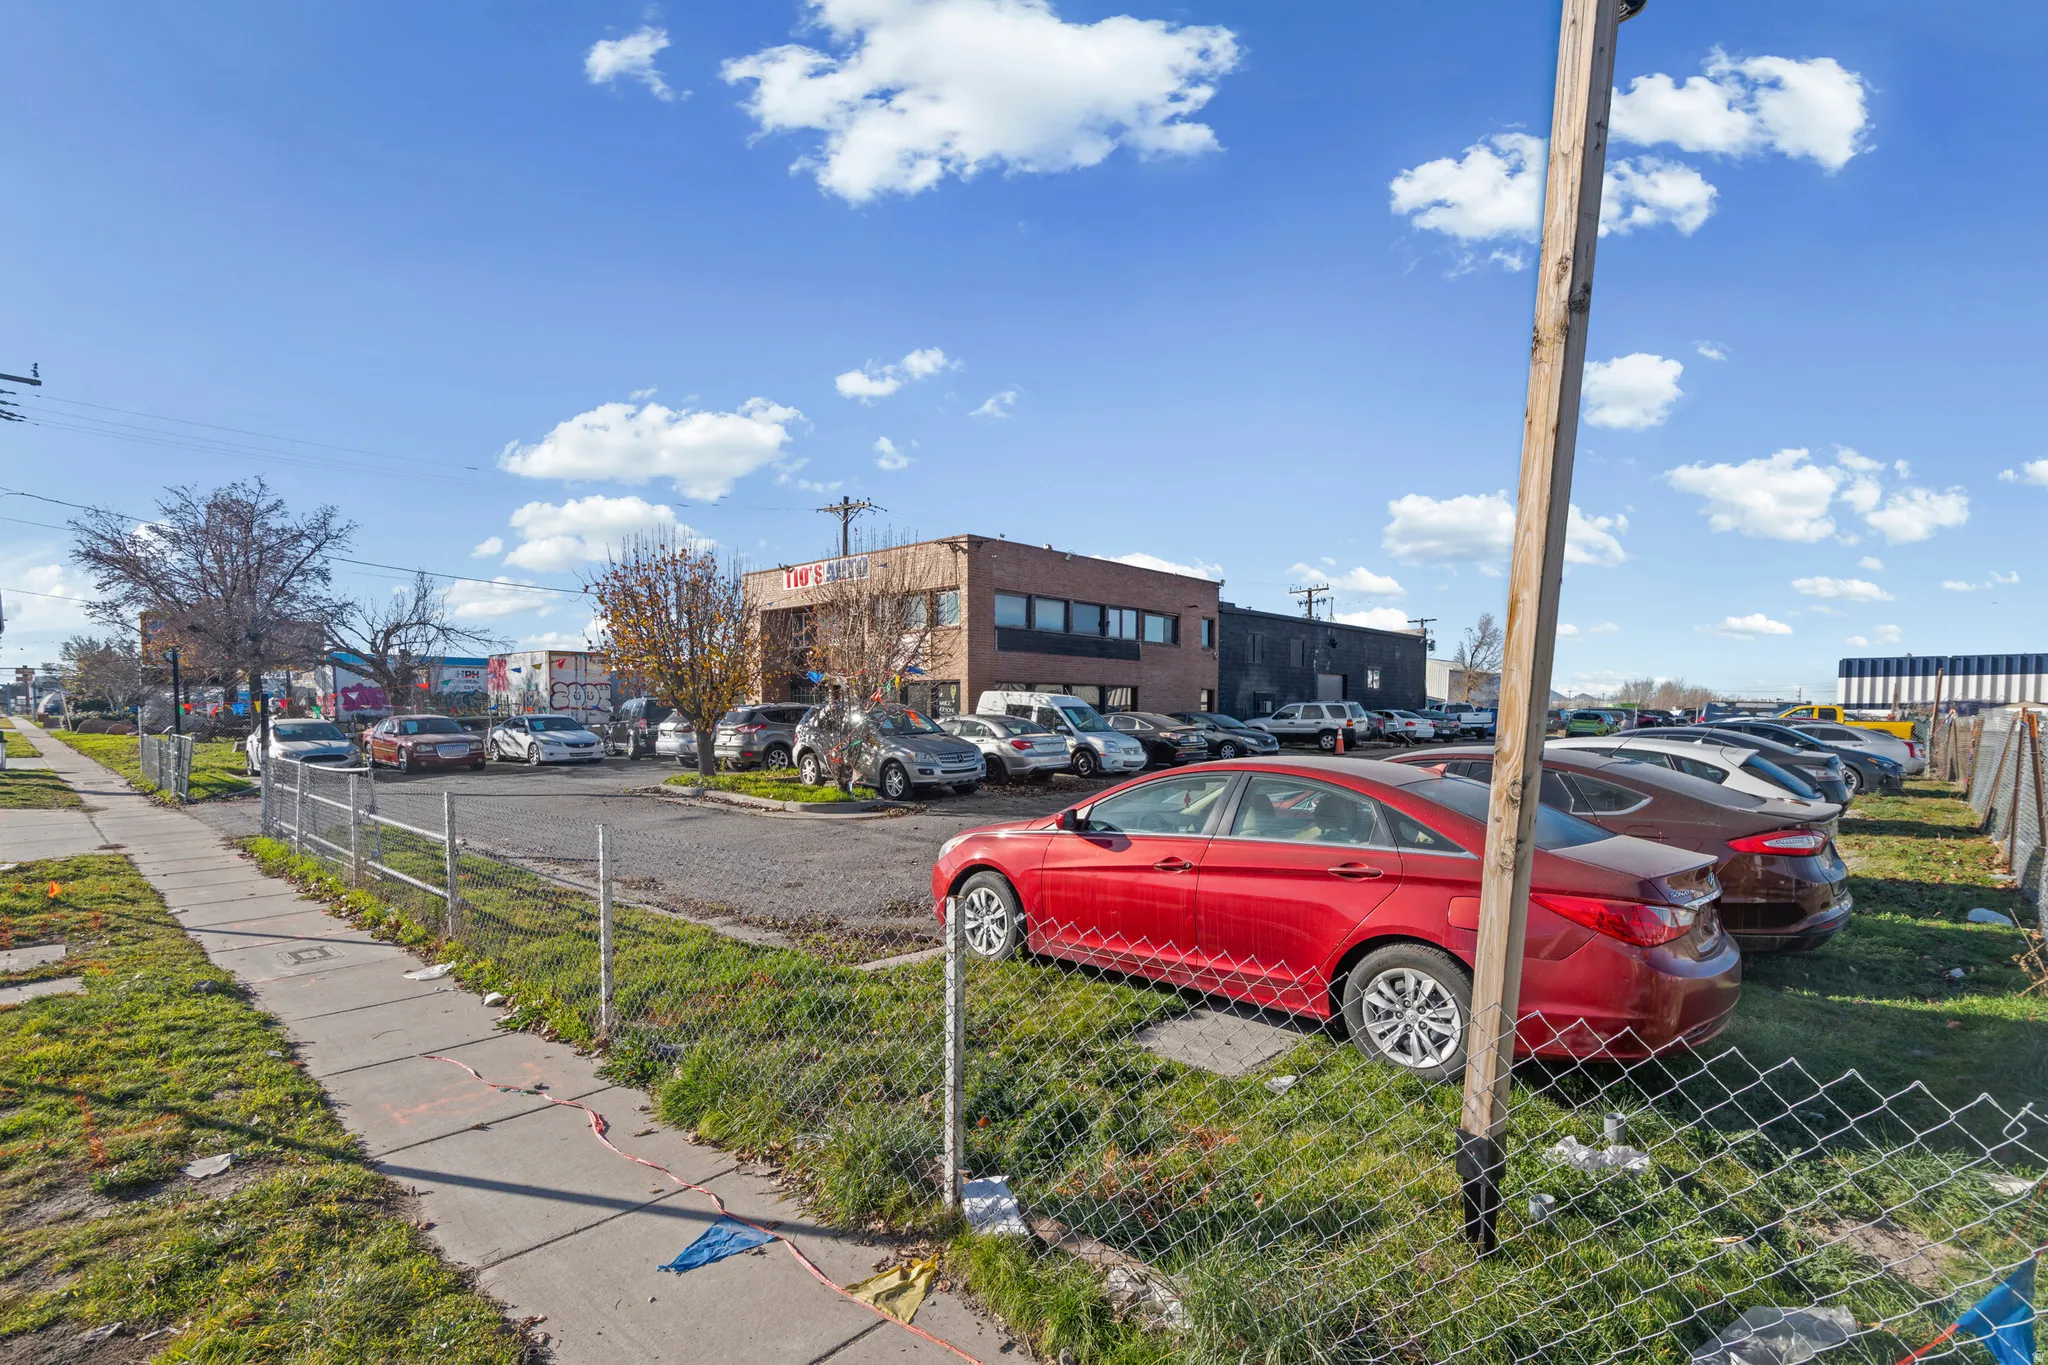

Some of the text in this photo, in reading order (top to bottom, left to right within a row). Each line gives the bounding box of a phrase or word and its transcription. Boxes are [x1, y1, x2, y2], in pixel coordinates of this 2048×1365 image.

[785, 556, 868, 589] TIO'S AUTO
[1669, 889, 1694, 899] SONATA
